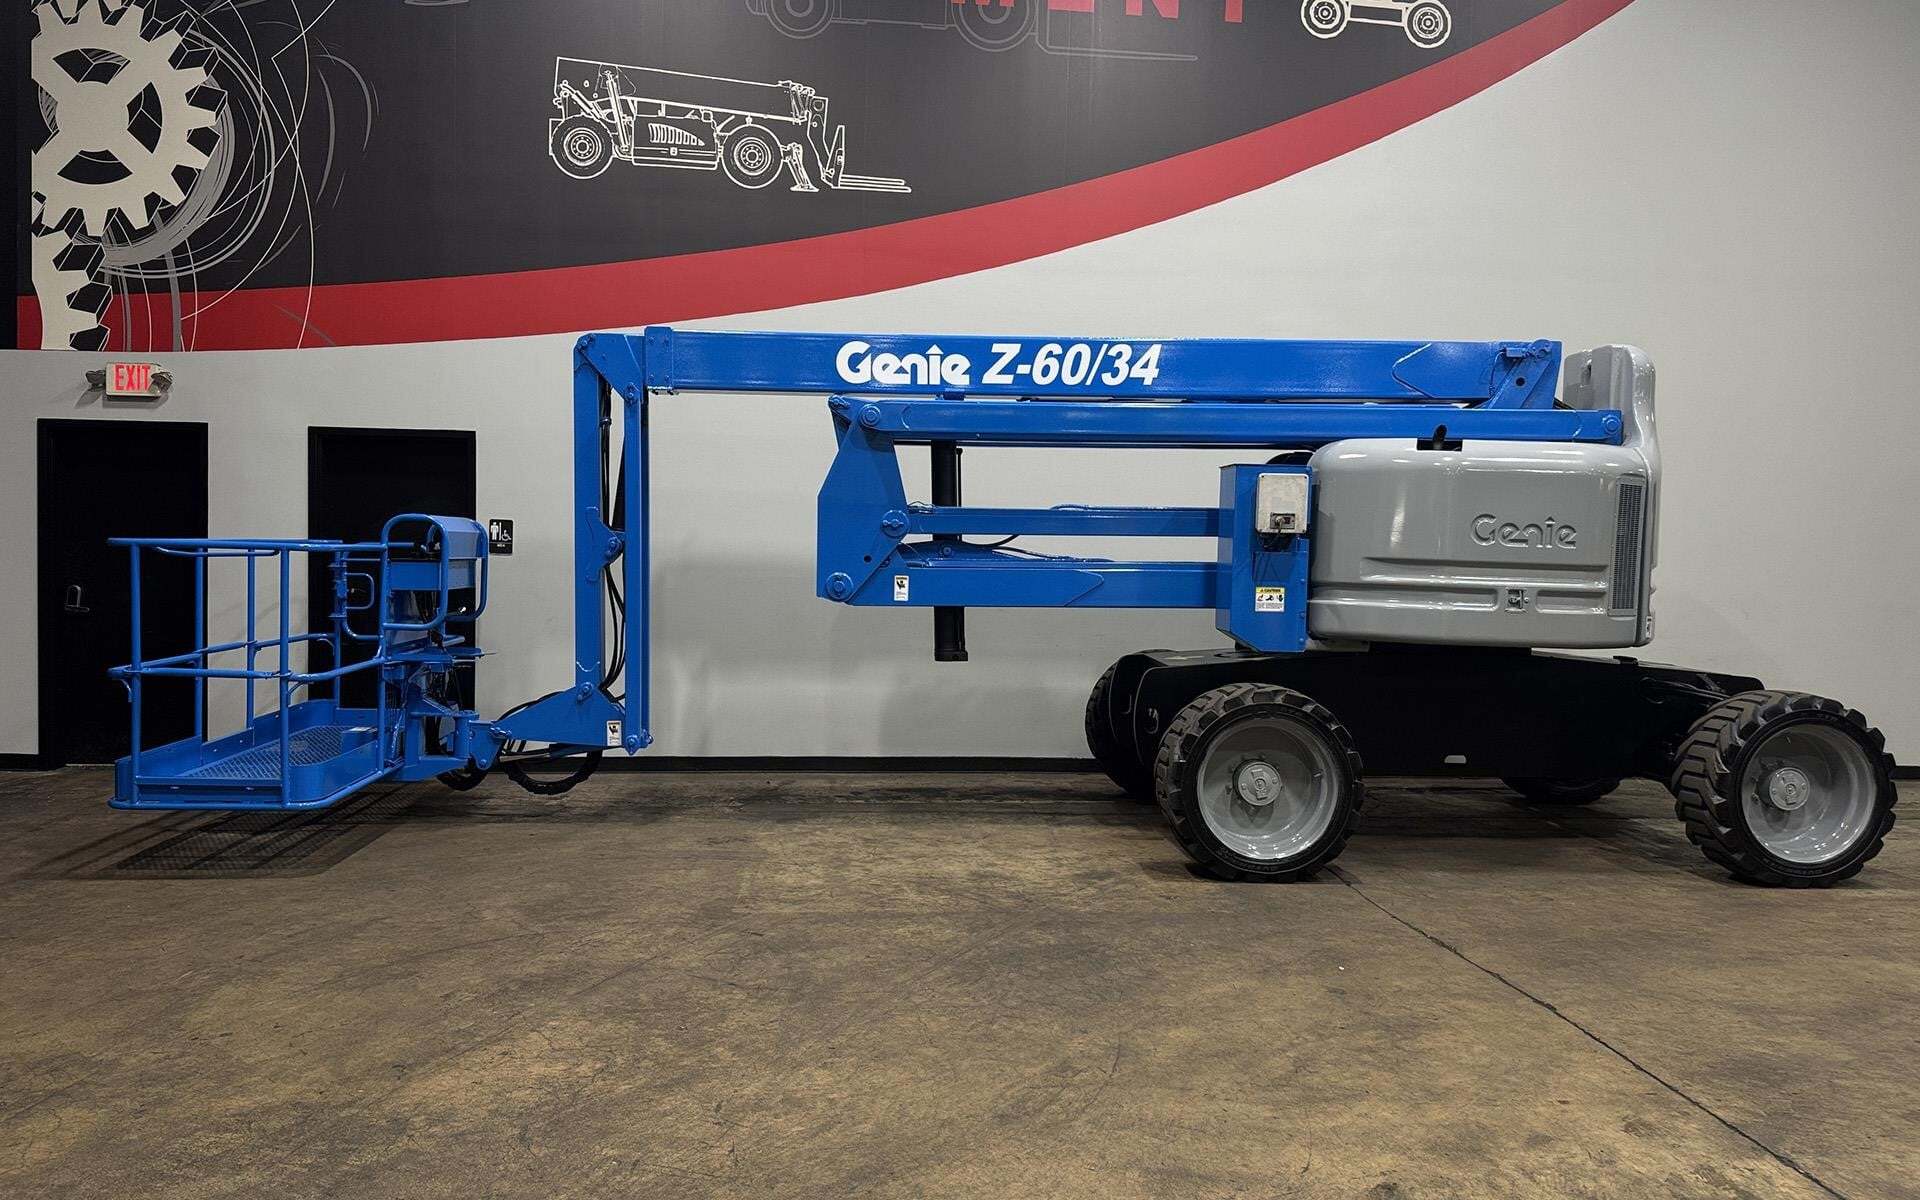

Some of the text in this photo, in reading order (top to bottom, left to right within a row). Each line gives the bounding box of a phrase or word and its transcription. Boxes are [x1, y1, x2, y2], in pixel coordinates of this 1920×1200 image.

[115, 364, 151, 391] EXIT
[835, 340, 1162, 386] Genie Z-60/34
[1471, 513, 1577, 549] Genie
